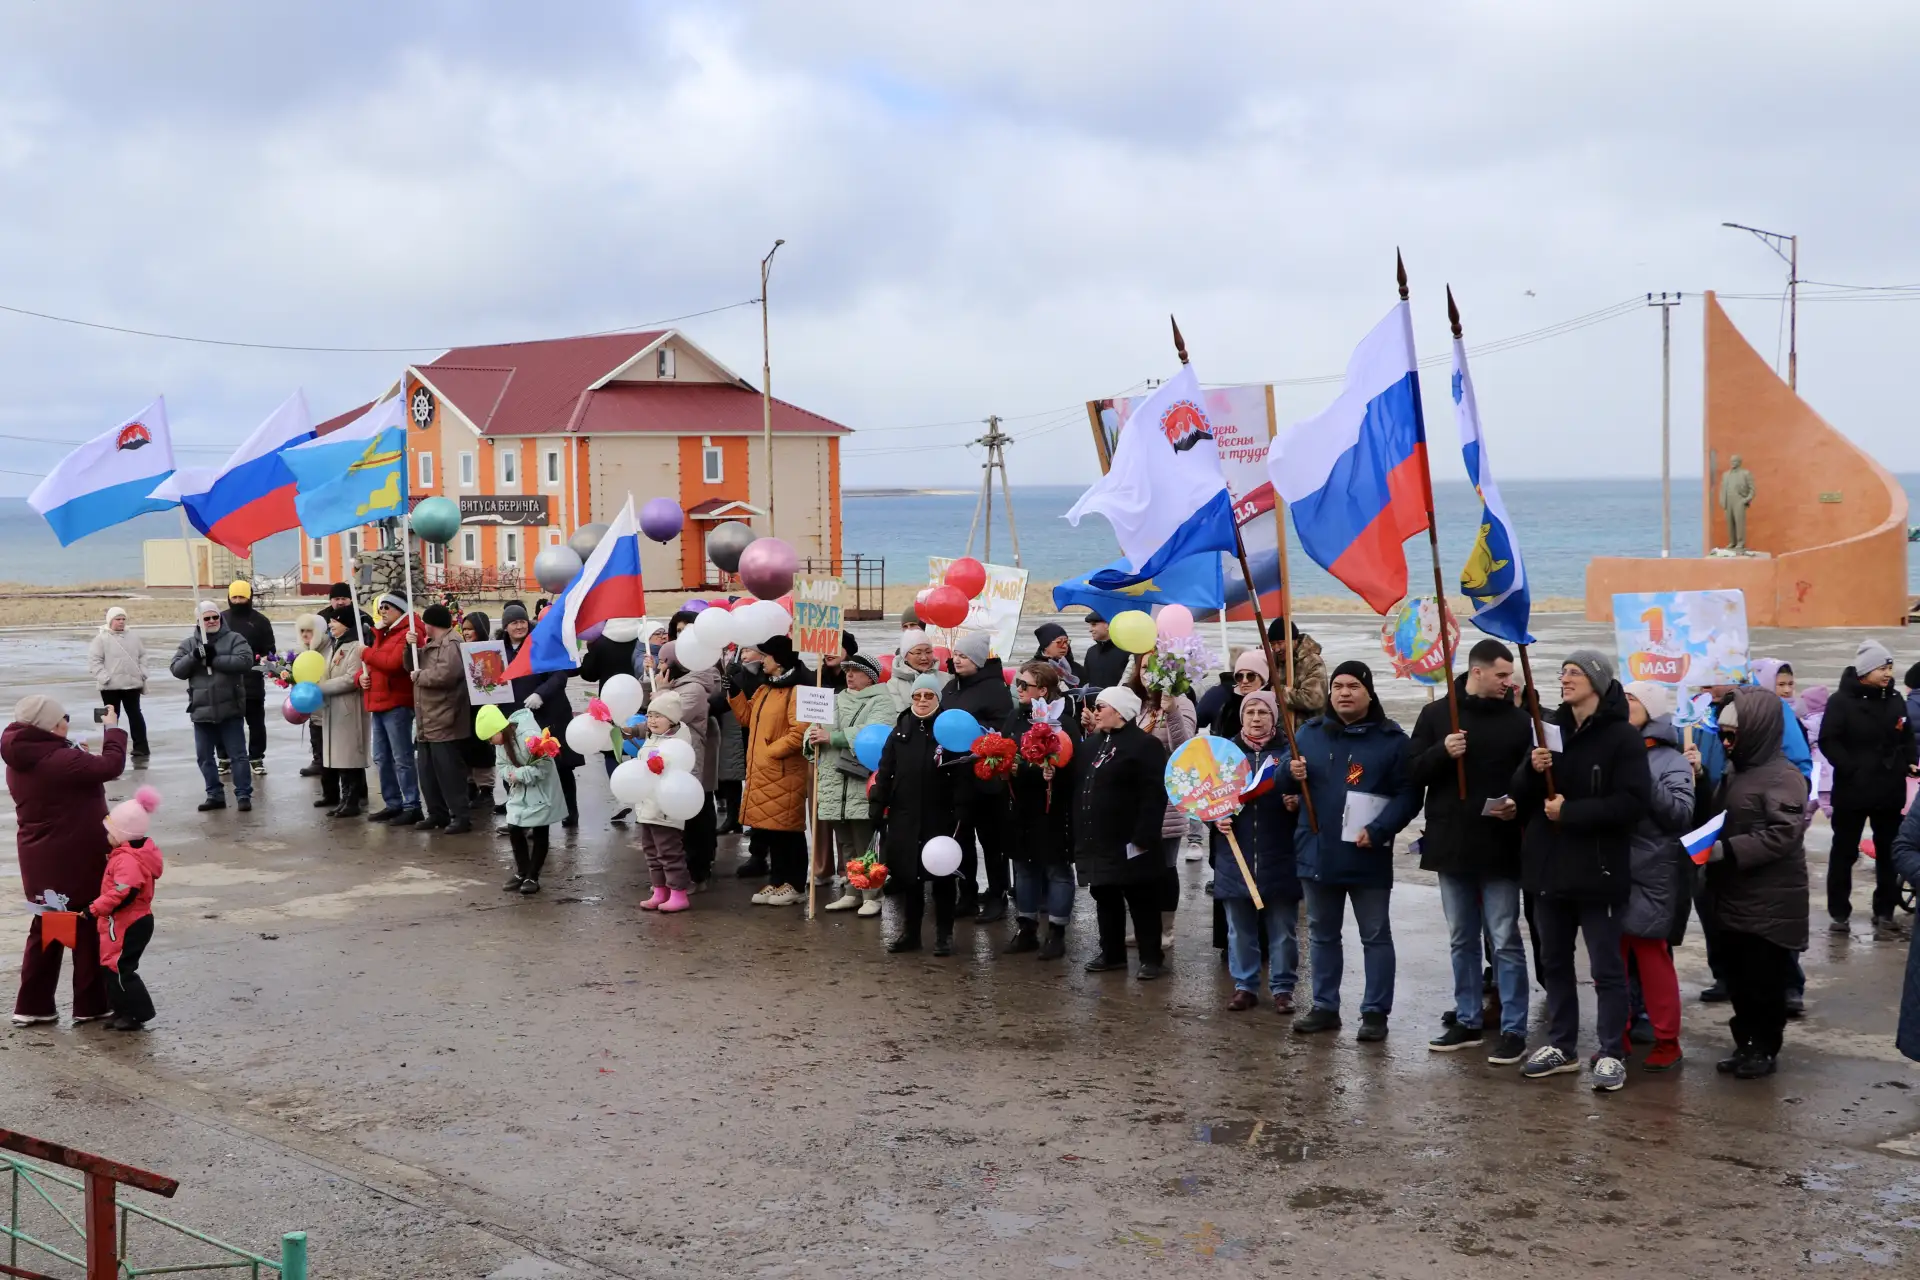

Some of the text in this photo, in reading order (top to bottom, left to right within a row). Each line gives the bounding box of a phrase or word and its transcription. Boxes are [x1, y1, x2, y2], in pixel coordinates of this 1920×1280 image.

[1212, 425, 1238, 440] день
[1217, 436, 1255, 447] весны
[1218, 450, 1226, 460] и
[461, 500, 540, 512] ВИТУСА БЕРИНГА
[1233, 501, 1258, 524] ая
[801, 579, 839, 602] МИР
[795, 602, 840, 629] ТРУД
[1641, 606, 1663, 645] 1
[1640, 661, 1677, 675] МАЯ
